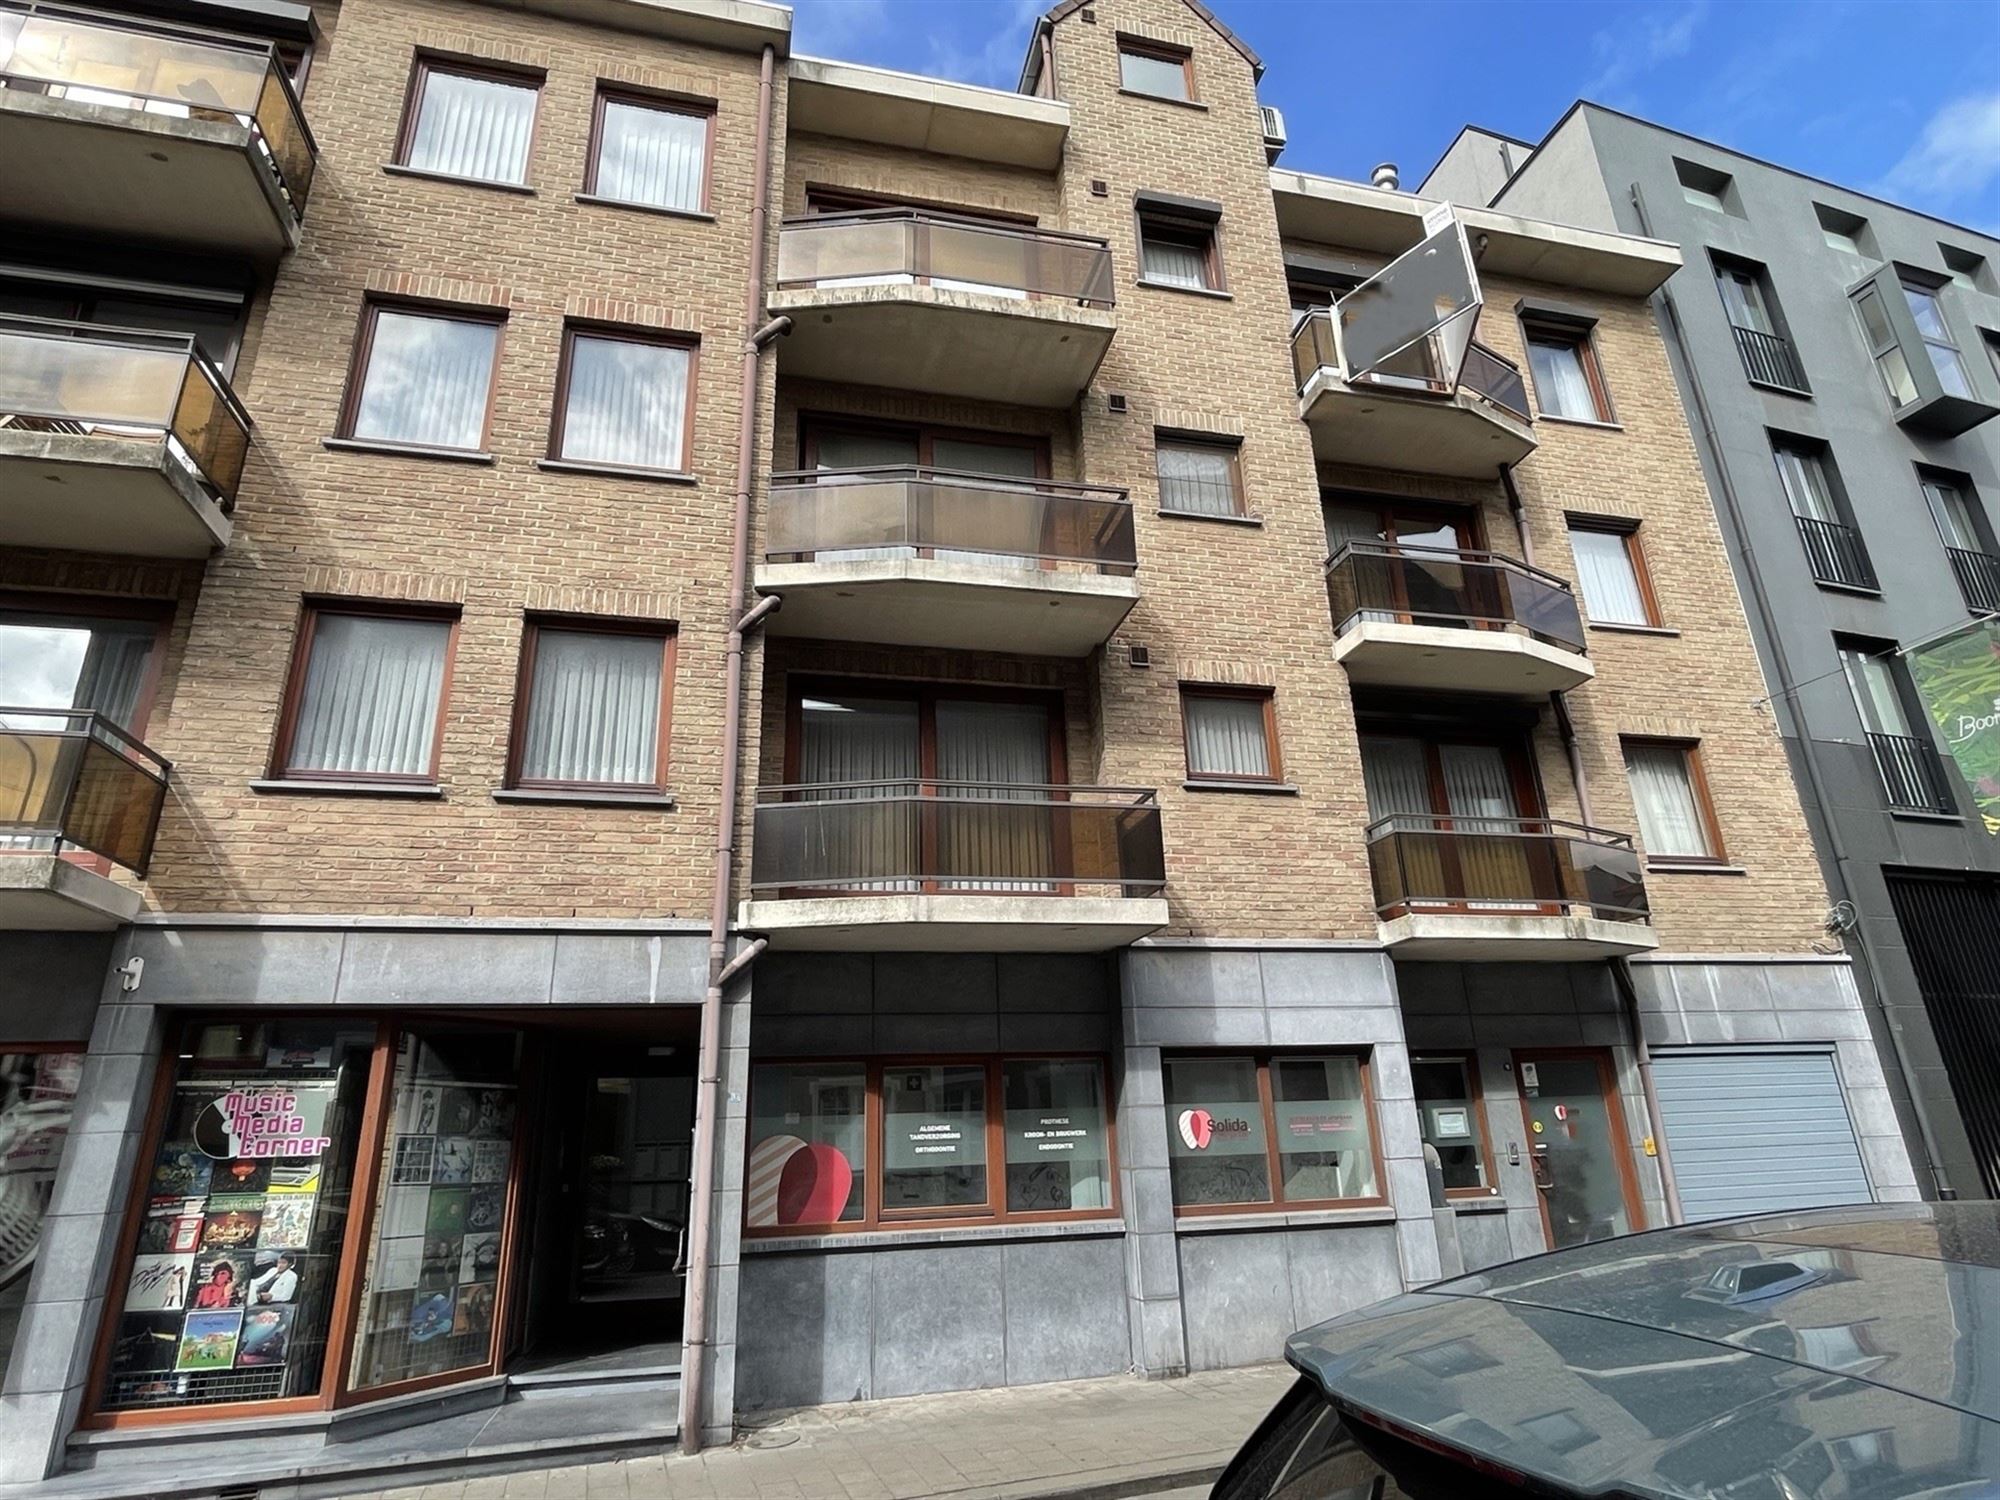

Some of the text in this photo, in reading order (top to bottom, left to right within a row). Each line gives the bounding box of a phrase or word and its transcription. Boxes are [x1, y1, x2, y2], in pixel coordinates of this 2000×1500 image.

[224, 1091, 297, 1113] Music
[231, 1114, 304, 1135] Media
[919, 1124, 951, 1132] ALGEMENE
[239, 1136, 331, 1157] Corner
[915, 1145, 956, 1153] ORTHODONTIE
